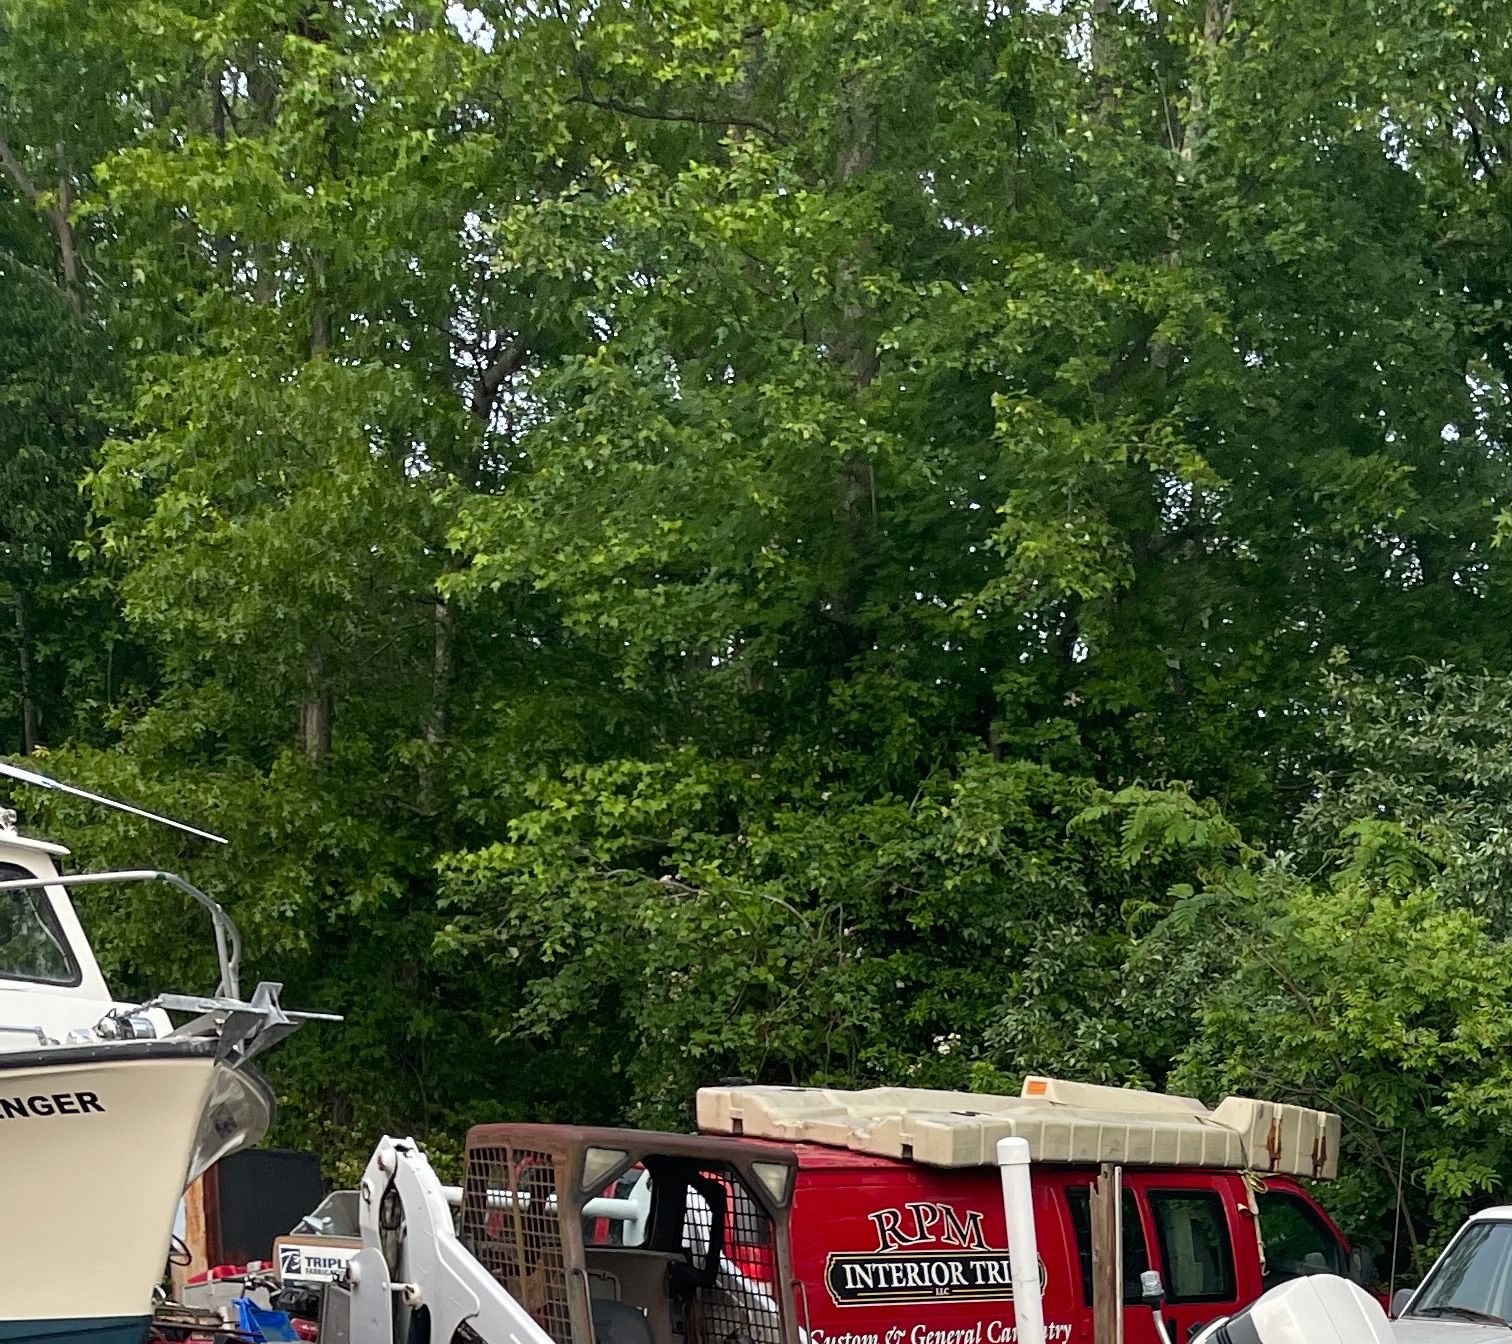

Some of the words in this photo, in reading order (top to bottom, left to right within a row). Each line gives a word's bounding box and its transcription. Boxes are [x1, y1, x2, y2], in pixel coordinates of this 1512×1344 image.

[0, 1091, 106, 1119] NGER
[868, 1202, 993, 1254] RPM
[304, 1256, 346, 1270] TRIPL
[841, 1261, 968, 1289] INTERIOR
[969, 1259, 1013, 1286] TRI
